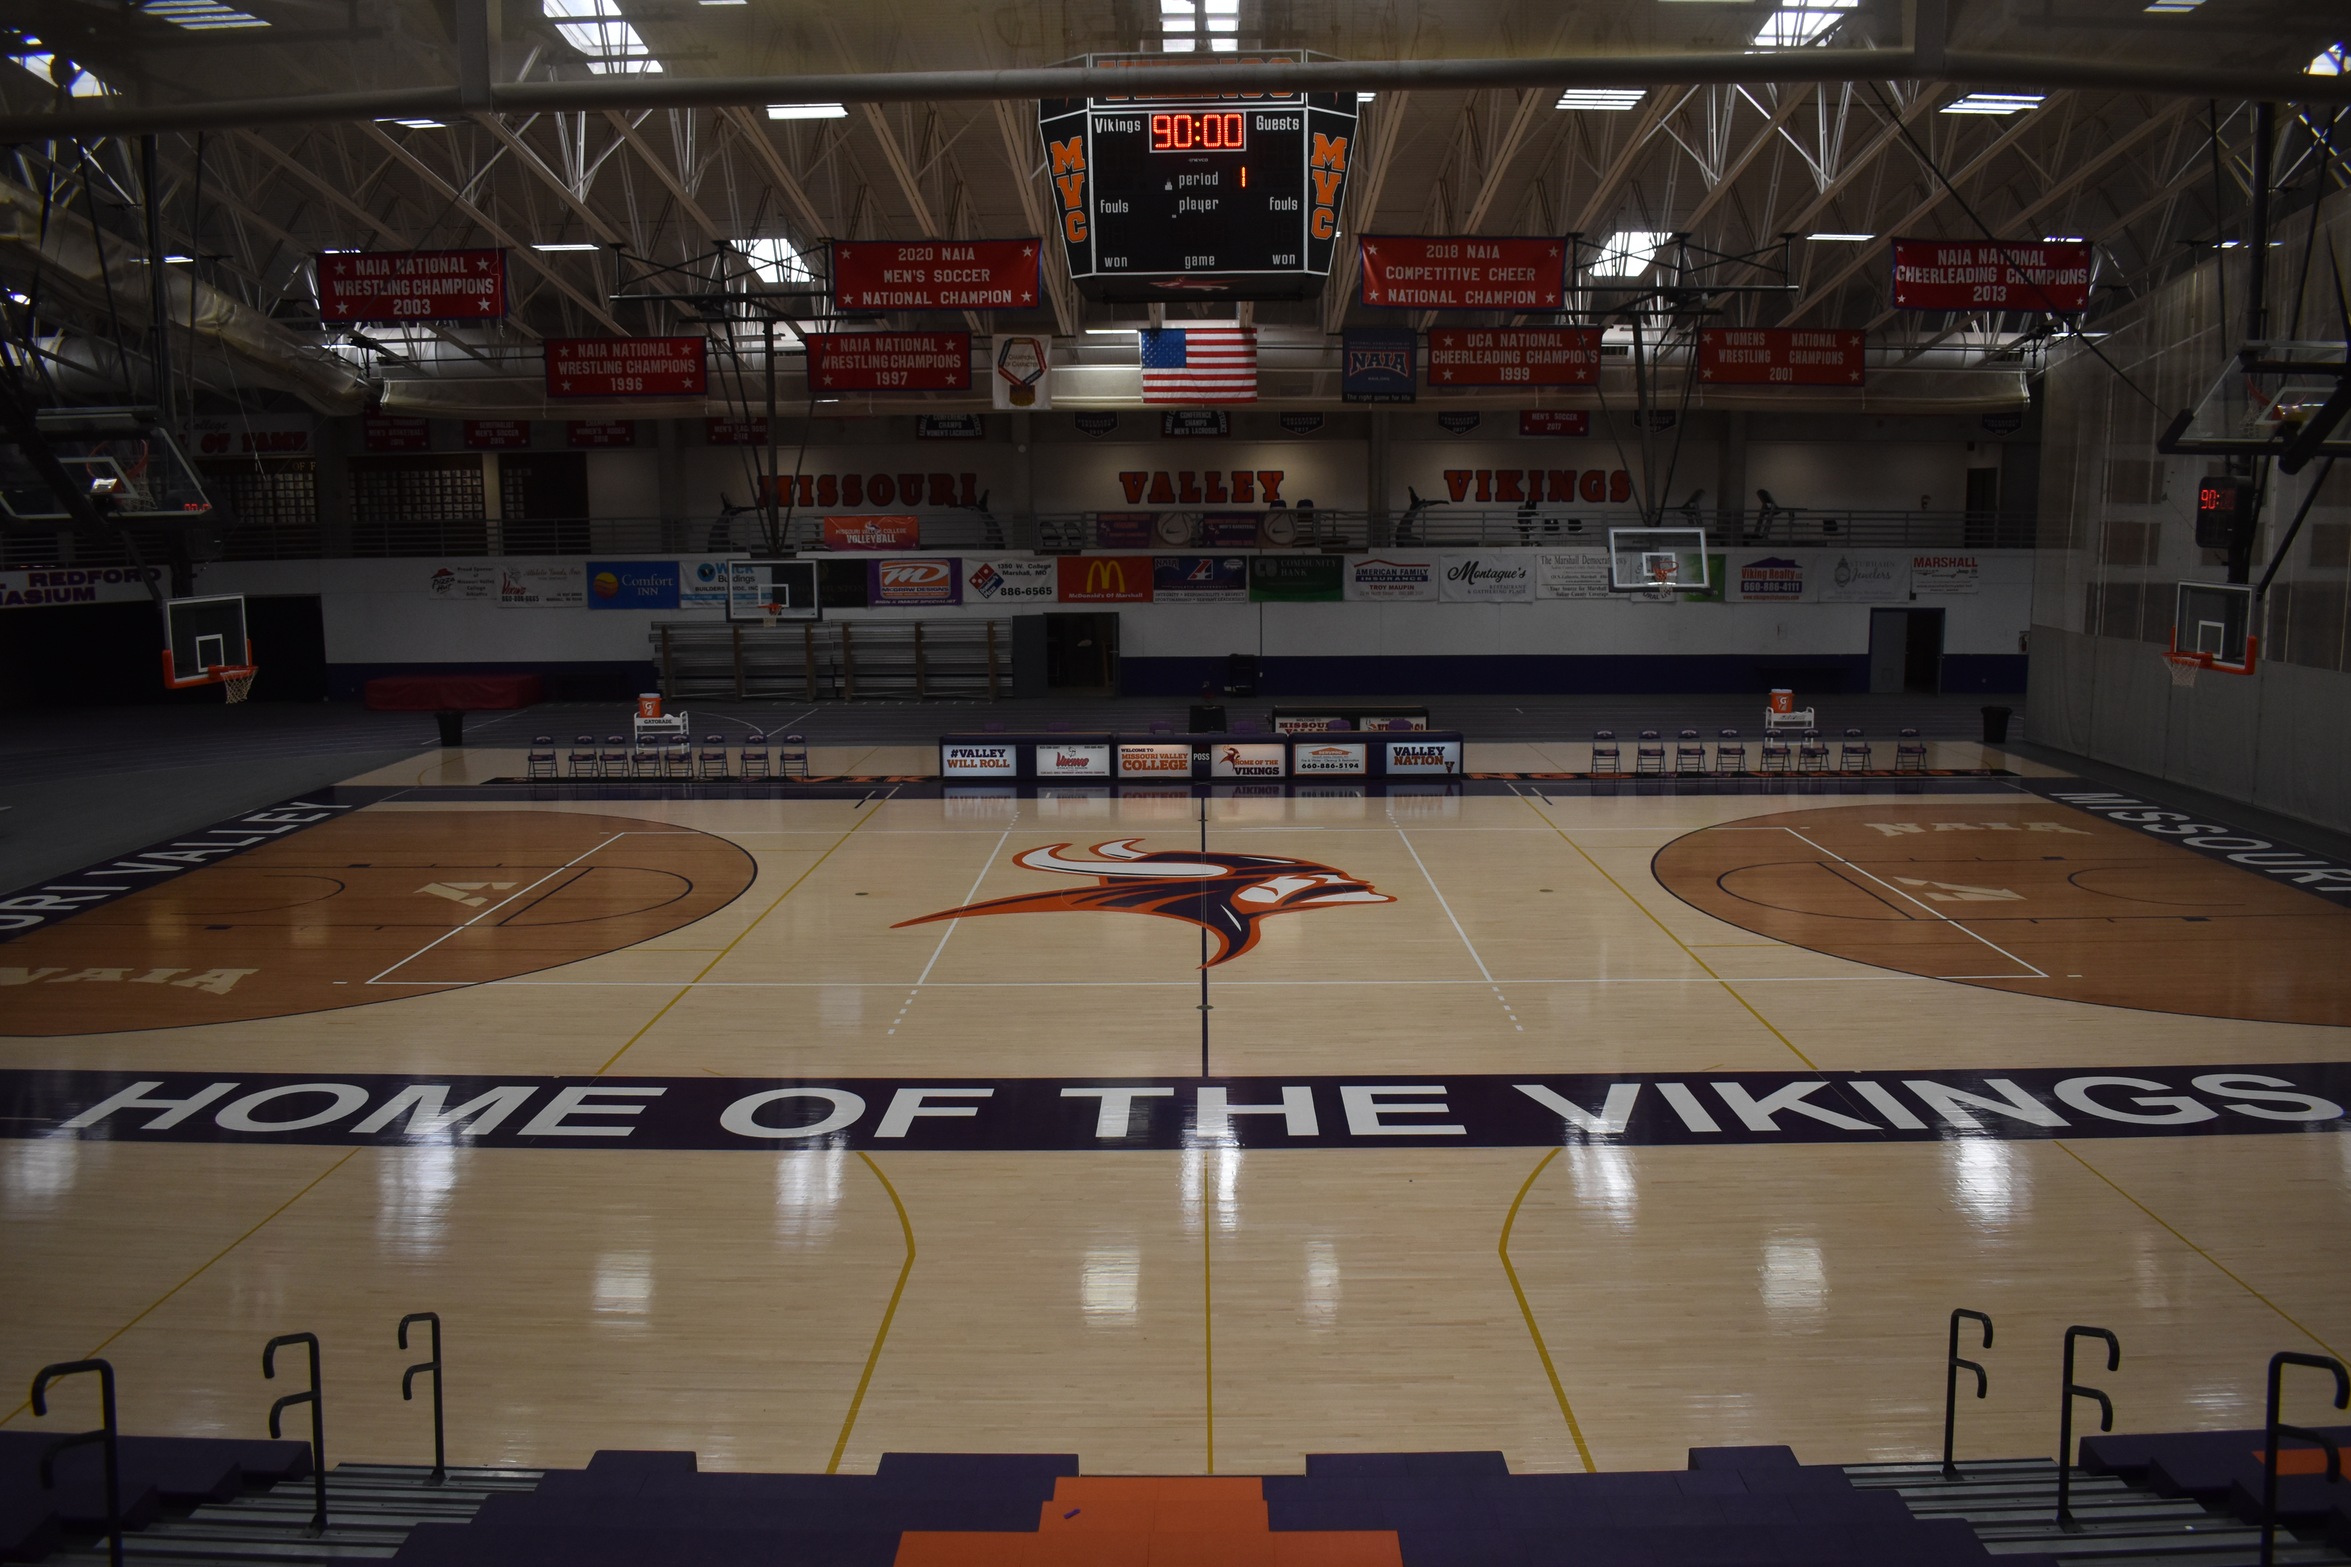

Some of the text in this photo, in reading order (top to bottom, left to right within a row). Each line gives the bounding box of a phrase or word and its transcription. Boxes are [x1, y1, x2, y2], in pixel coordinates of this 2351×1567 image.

[1095, 117, 1141, 133] Vikings
[1152, 113, 1243, 149] 90:00
[1256, 116, 1300, 131] Guests
[1179, 171, 1219, 188] period
[1310, 132, 1348, 240] MVC
[1050, 134, 1087, 243] MVC
[1100, 200, 1129, 214] fouls
[1179, 197, 1219, 212] player
[1269, 197, 1298, 211] fouls
[898, 248, 975, 261] 2020 NAIA
[1272, 253, 1296, 266] won
[1426, 245, 1500, 259] 2018 NAIA
[1938, 249, 2047, 267] NAIA NATIONAL
[356, 258, 468, 276] NAIA NATIONAL
[1104, 255, 1128, 268] won
[1184, 255, 1216, 269] game
[884, 269, 990, 283] MEN'S SOCCER
[1386, 266, 1536, 282] COMPETITIVE CHEER
[1896, 266, 2087, 286] CHEERLEADING CHAMPIONS
[334, 277, 494, 297] WRESTLING CHAMPIONS
[1973, 286, 2007, 302] 2013
[862, 290, 1012, 305] NATIONAL CHAMPION
[1388, 289, 1536, 305] NATIONAL CHAMPION
[393, 299, 431, 316] 2003
[840, 338, 938, 352] NAIA NATIONAL
[1468, 333, 1563, 348] UCA NATIONAL
[1726, 332, 1838, 348] WOMENS NATIONAL
[578, 343, 673, 358] NAIA NATIONAL
[1432, 350, 1598, 365] CHEERLEADING CHAMPIONS
[1718, 349, 1844, 366] WRESTLING CHAMPIONS
[558, 359, 696, 375] WRESTLING CHAMPIONS
[822, 354, 961, 369] WRESTLING CHAMPIONS
[1350, 352, 1410, 378] NAIA
[876, 372, 908, 385] 1997
[1500, 367, 1530, 381] 1999
[1770, 367, 1793, 382] 2001
[610, 377, 643, 392] 1996
[757, 474, 977, 508] MISSOURI
[1120, 471, 1285, 504] VALLEY
[1444, 470, 1632, 503] VIKINGS
[846, 534, 897, 544] VOLLEYBALL
[1281, 558, 1336, 569] COMMUNITY
[1555, 555, 1580, 565] Marshall
[1914, 557, 1978, 568] MARSHALL
[29, 568, 162, 588] REDFORD
[718, 575, 756, 584] Budings
[1281, 568, 1308, 577] BANK
[1356, 568, 1429, 576] AMERICAN FAMILY
[1448, 560, 1527, 585] Montague's
[1742, 568, 1795, 580] Viking Realty
[622, 574, 675, 587] Comfort
[1744, 582, 1800, 592] 660-886-4111
[0, 586, 96, 605] ASIUM
[638, 586, 659, 596] INN
[1001, 586, 1053, 597] 886-6565
[950, 749, 1006, 758] #VALLEY
[1159, 752, 1188, 760] VALLEY
[1193, 752, 1211, 762] POSS
[1393, 746, 1446, 756] VALLEY
[947, 759, 1010, 768] WILL ROLL
[1122, 760, 1188, 771] COLLEGE
[1394, 756, 1444, 766] NATION
[1235, 766, 1280, 776] VIKINGS
[1863, 821, 2095, 837] NAIA
[83, 800, 352, 876] VALLEY
[40, 1072, 2347, 1138] HOME OF THE VIKINGS
